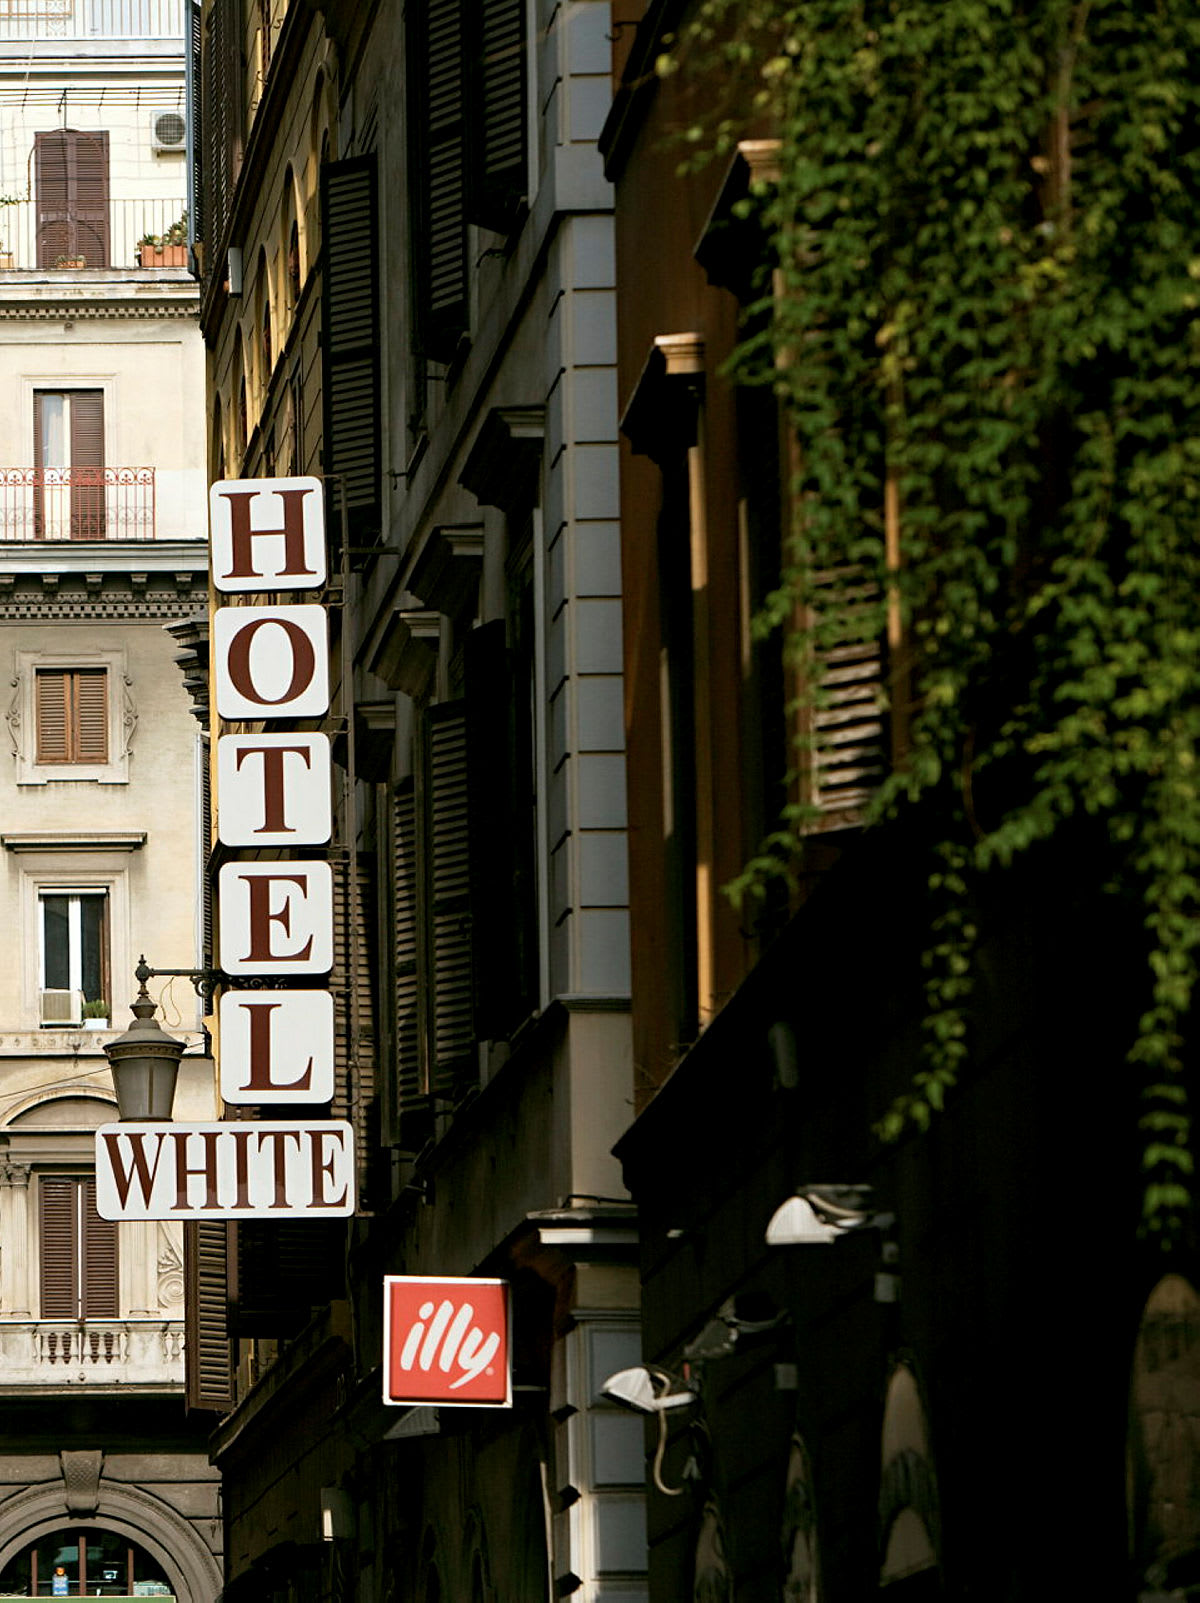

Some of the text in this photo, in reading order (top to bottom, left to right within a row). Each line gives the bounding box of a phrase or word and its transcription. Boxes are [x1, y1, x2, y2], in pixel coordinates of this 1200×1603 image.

[218, 488, 318, 1092] HOTEL
[101, 1129, 348, 1211] WHITE
[400, 1299, 501, 1389] illy
